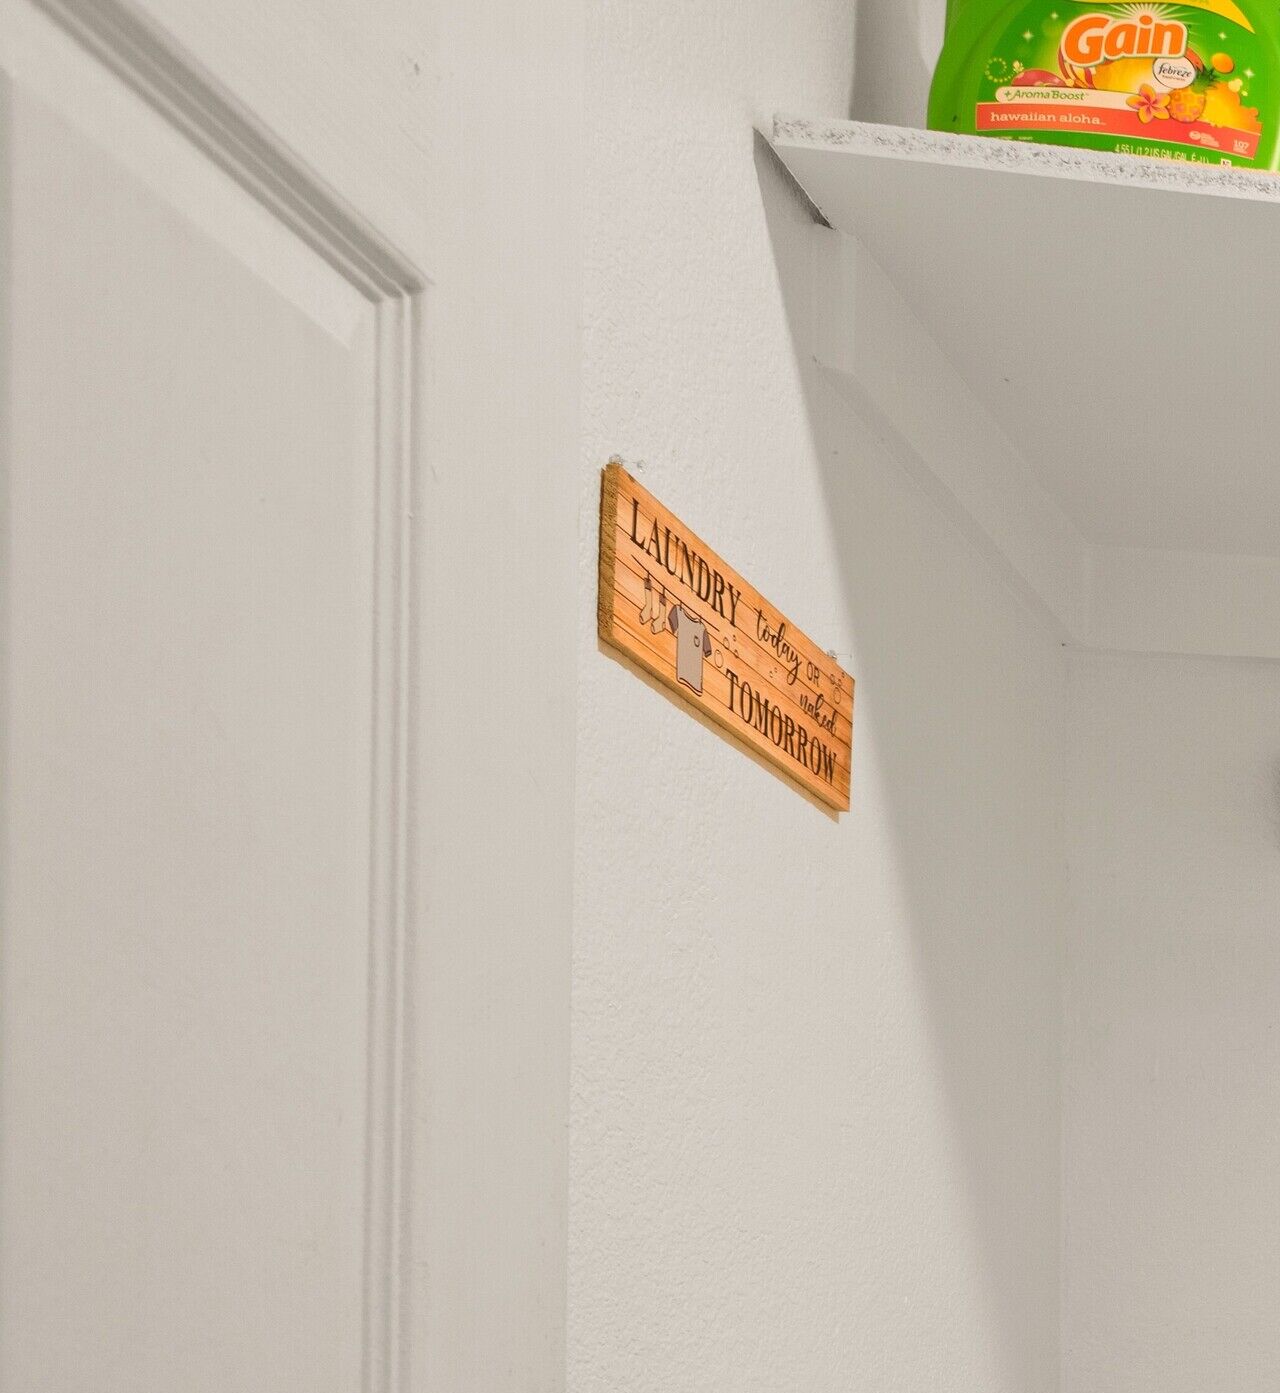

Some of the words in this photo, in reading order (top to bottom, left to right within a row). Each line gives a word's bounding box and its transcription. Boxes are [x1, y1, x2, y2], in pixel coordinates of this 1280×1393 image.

[1063, 14, 1186, 66] Gain
[1158, 62, 1192, 78] febreze
[990, 111, 1056, 123] hawaiian
[1059, 112, 1101, 125] aloha
[630, 497, 742, 629] LAUNDRY
[753, 606, 803, 686] today
[726, 668, 838, 787] TOMORROW
